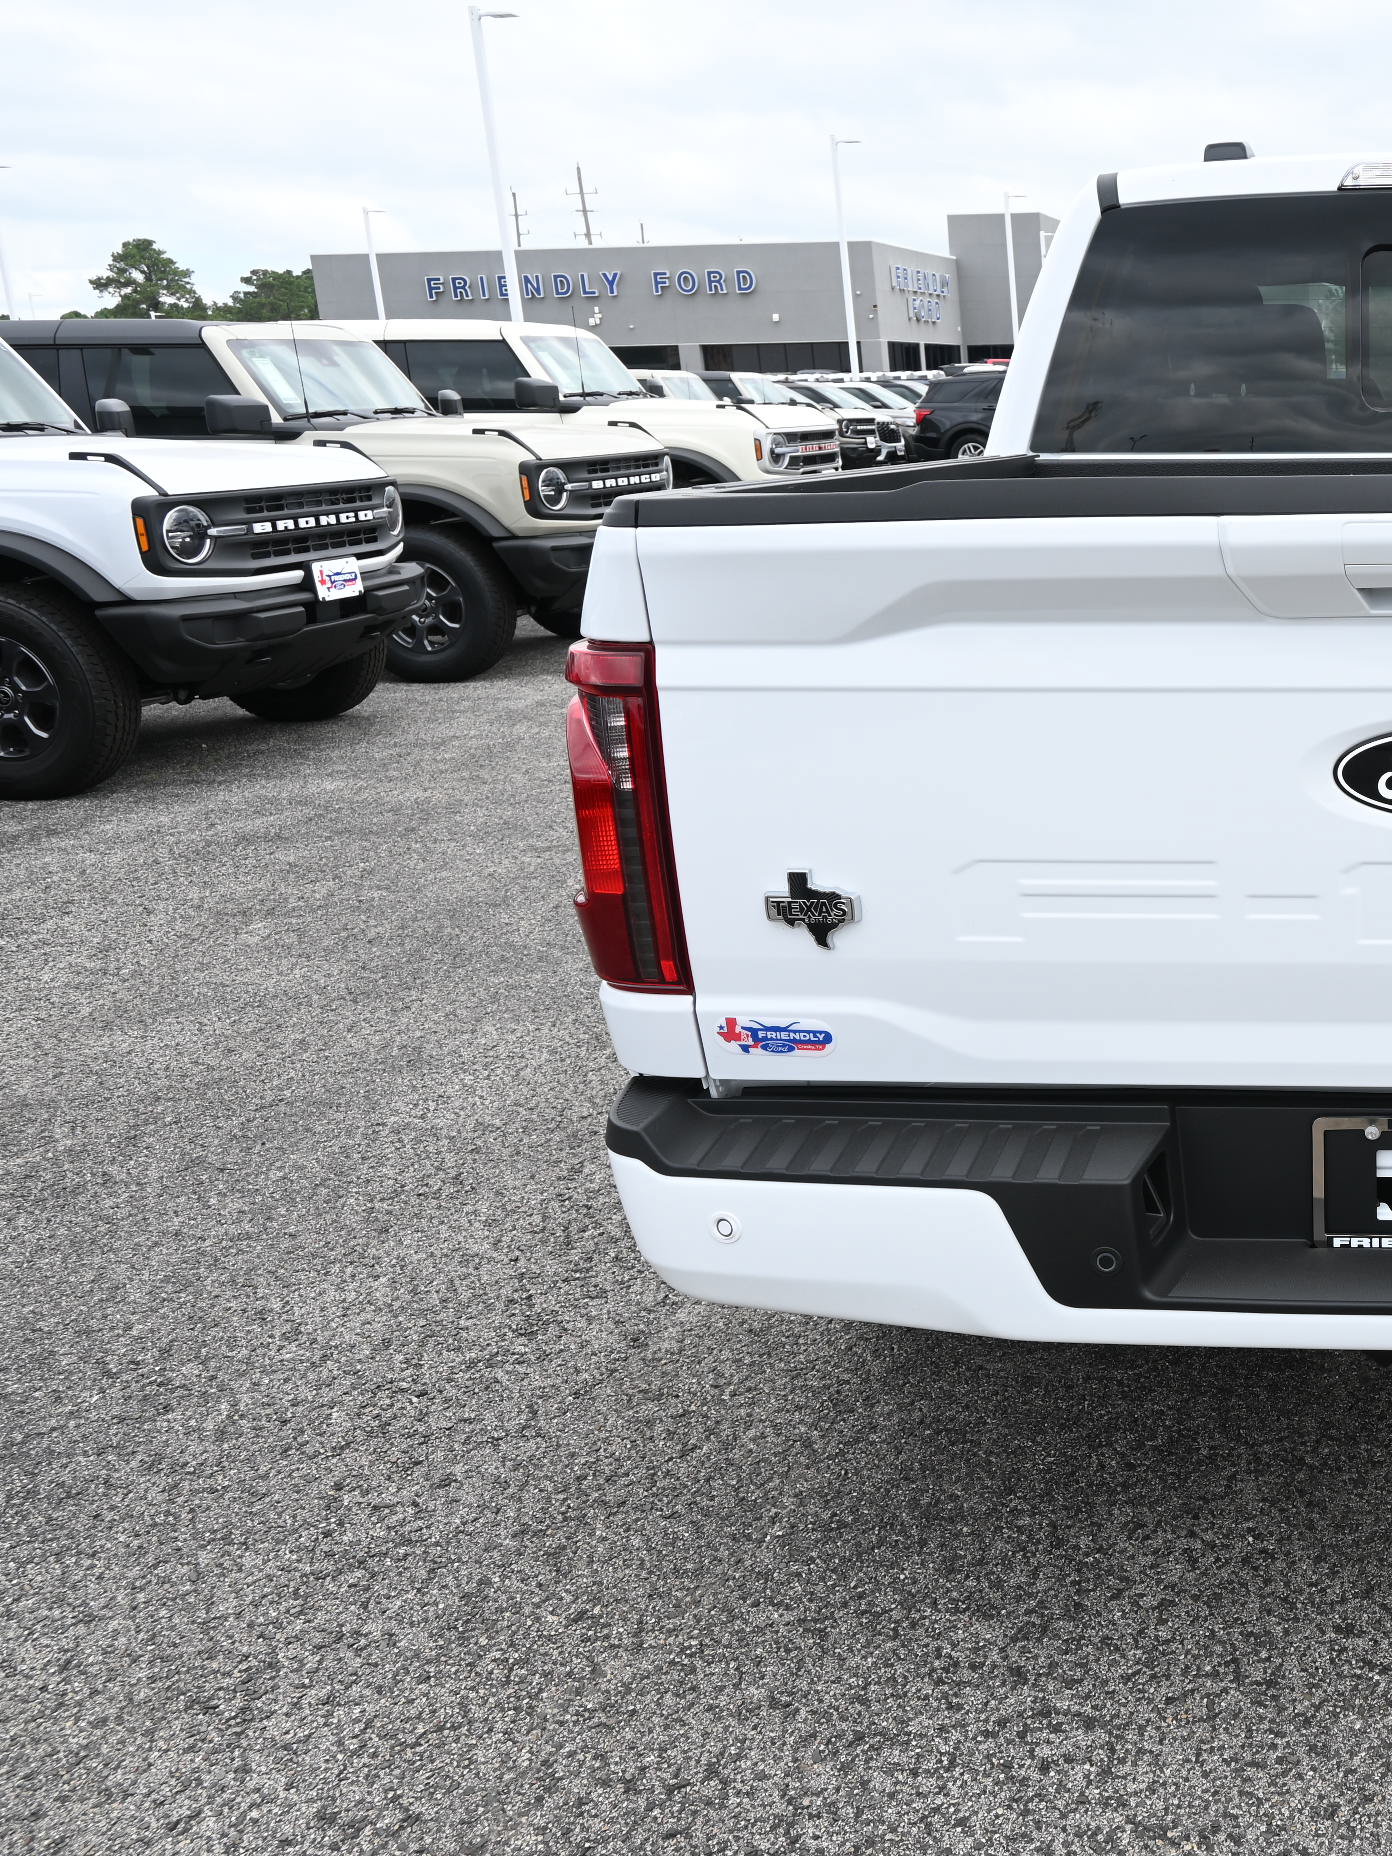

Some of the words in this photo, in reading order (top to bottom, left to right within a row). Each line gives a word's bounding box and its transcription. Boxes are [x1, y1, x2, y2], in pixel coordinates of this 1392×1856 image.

[425, 271, 620, 300] FRIENDLY
[651, 268, 756, 295] FORD
[891, 264, 950, 296] FRIENDLY
[908, 297, 941, 321] FORD
[592, 473, 660, 489] BRONCO
[252, 510, 374, 534] BRONCO
[769, 899, 848, 918] TEXAS
[757, 1031, 826, 1041] FRIENDLY
[766, 1043, 789, 1052] Ford
